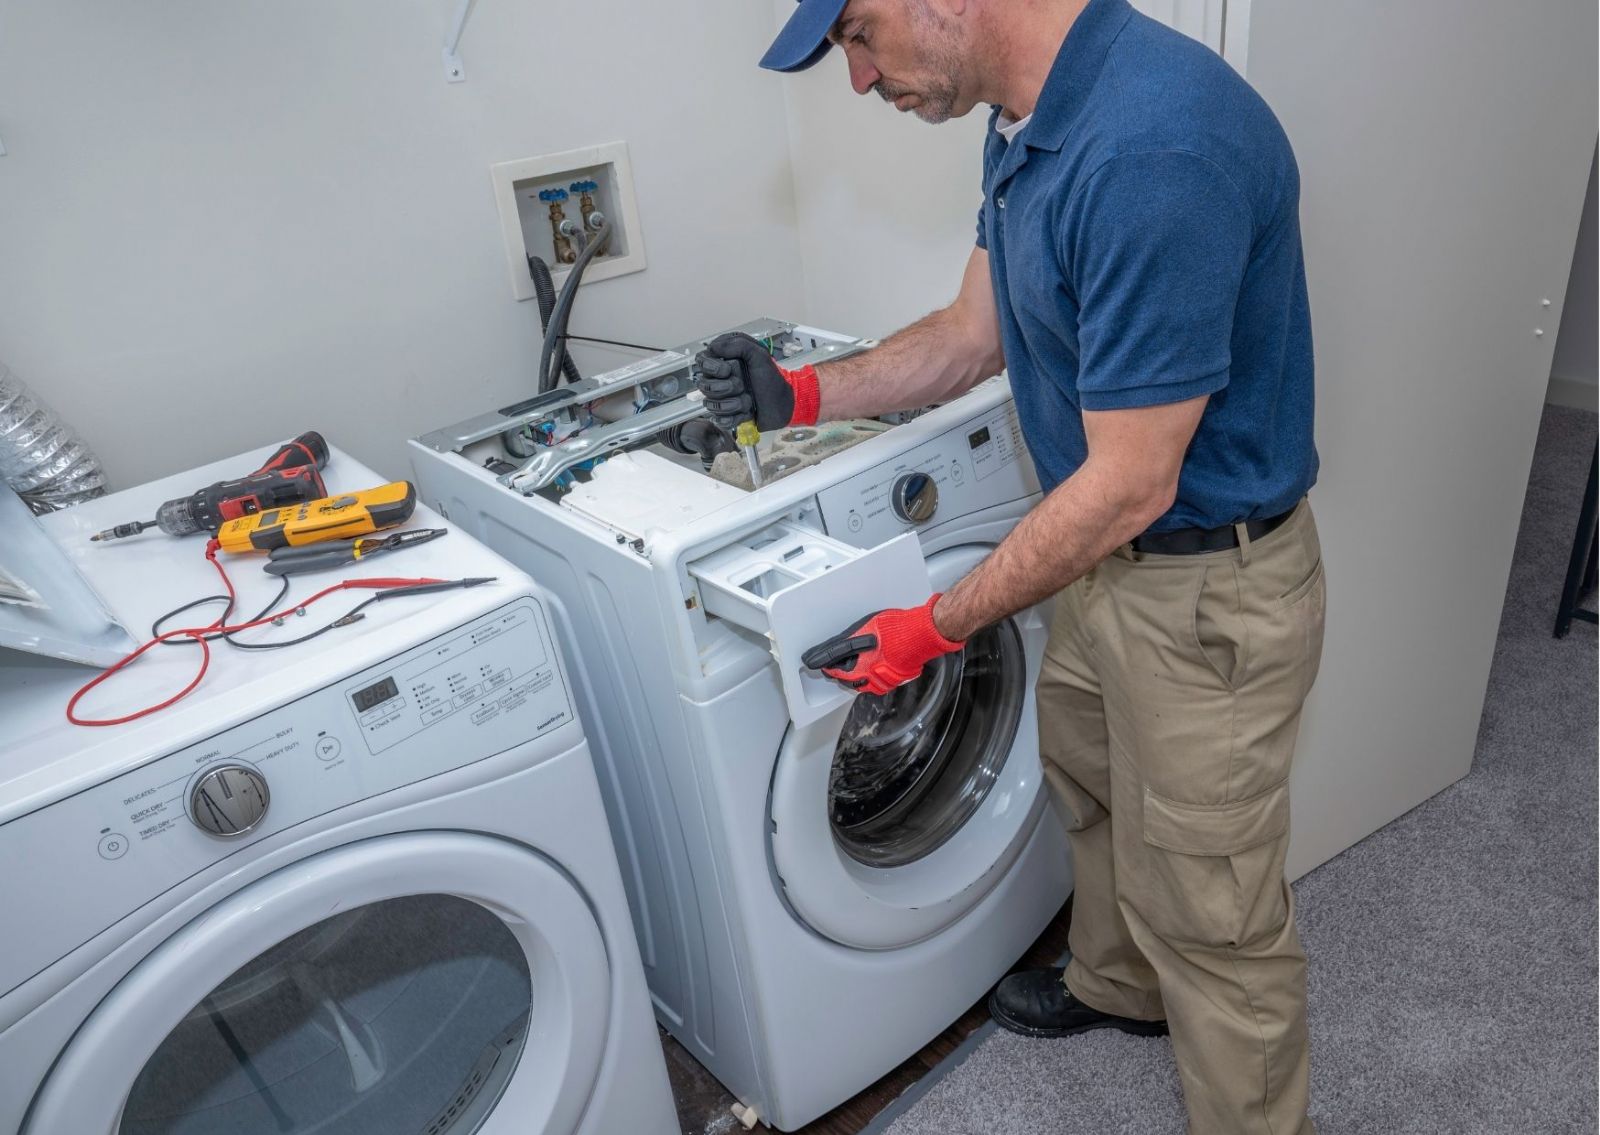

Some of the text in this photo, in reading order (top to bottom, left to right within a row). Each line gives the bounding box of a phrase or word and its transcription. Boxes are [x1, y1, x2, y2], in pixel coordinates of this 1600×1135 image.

[123, 788, 157, 805] DELICATES
[130, 802, 163, 821] QUICK DRY
[158, 819, 169, 829] DRY
